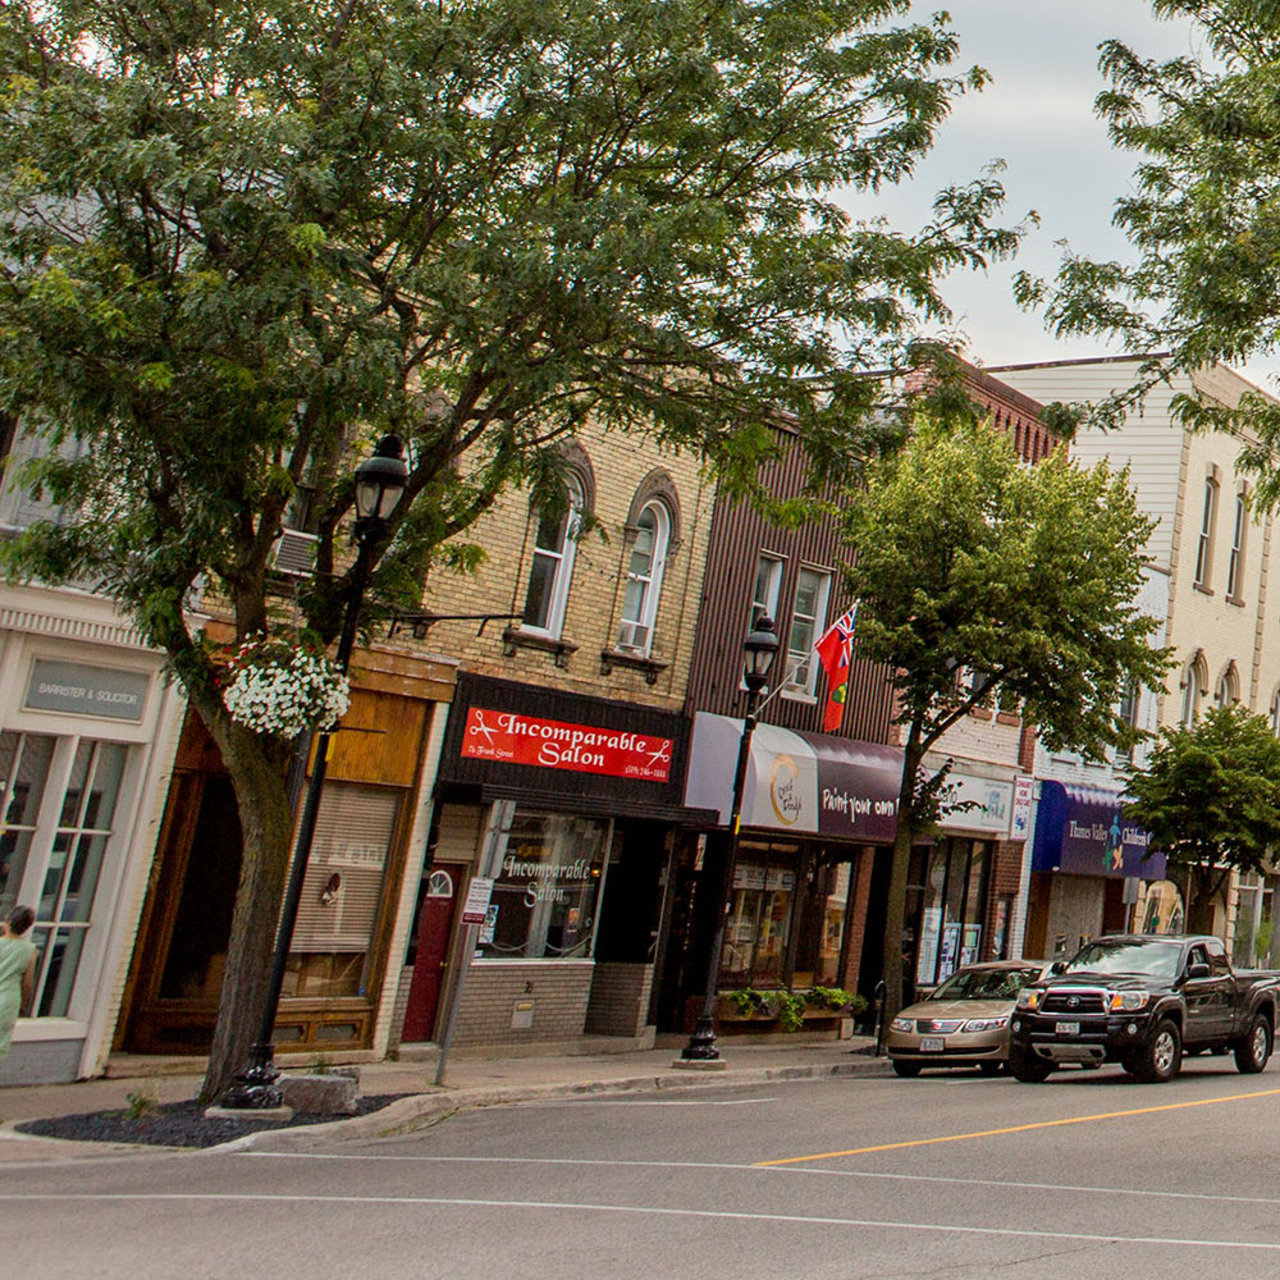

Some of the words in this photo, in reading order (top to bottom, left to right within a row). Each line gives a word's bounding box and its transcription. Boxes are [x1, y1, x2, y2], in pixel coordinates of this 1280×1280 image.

[39, 683, 85, 698] BARRISTER
[96, 690, 138, 705] SOLICITOR
[498, 713, 646, 752] Incomparable
[538, 742, 604, 766] Salon
[823, 787, 848, 814] Paint
[849, 796, 872, 823] your
[875, 800, 895, 817] own
[1070, 820, 1091, 839] Thames
[1092, 823, 1108, 846] Valley
[504, 855, 591, 881] Incomparable
[524, 881, 564, 908] Salon
